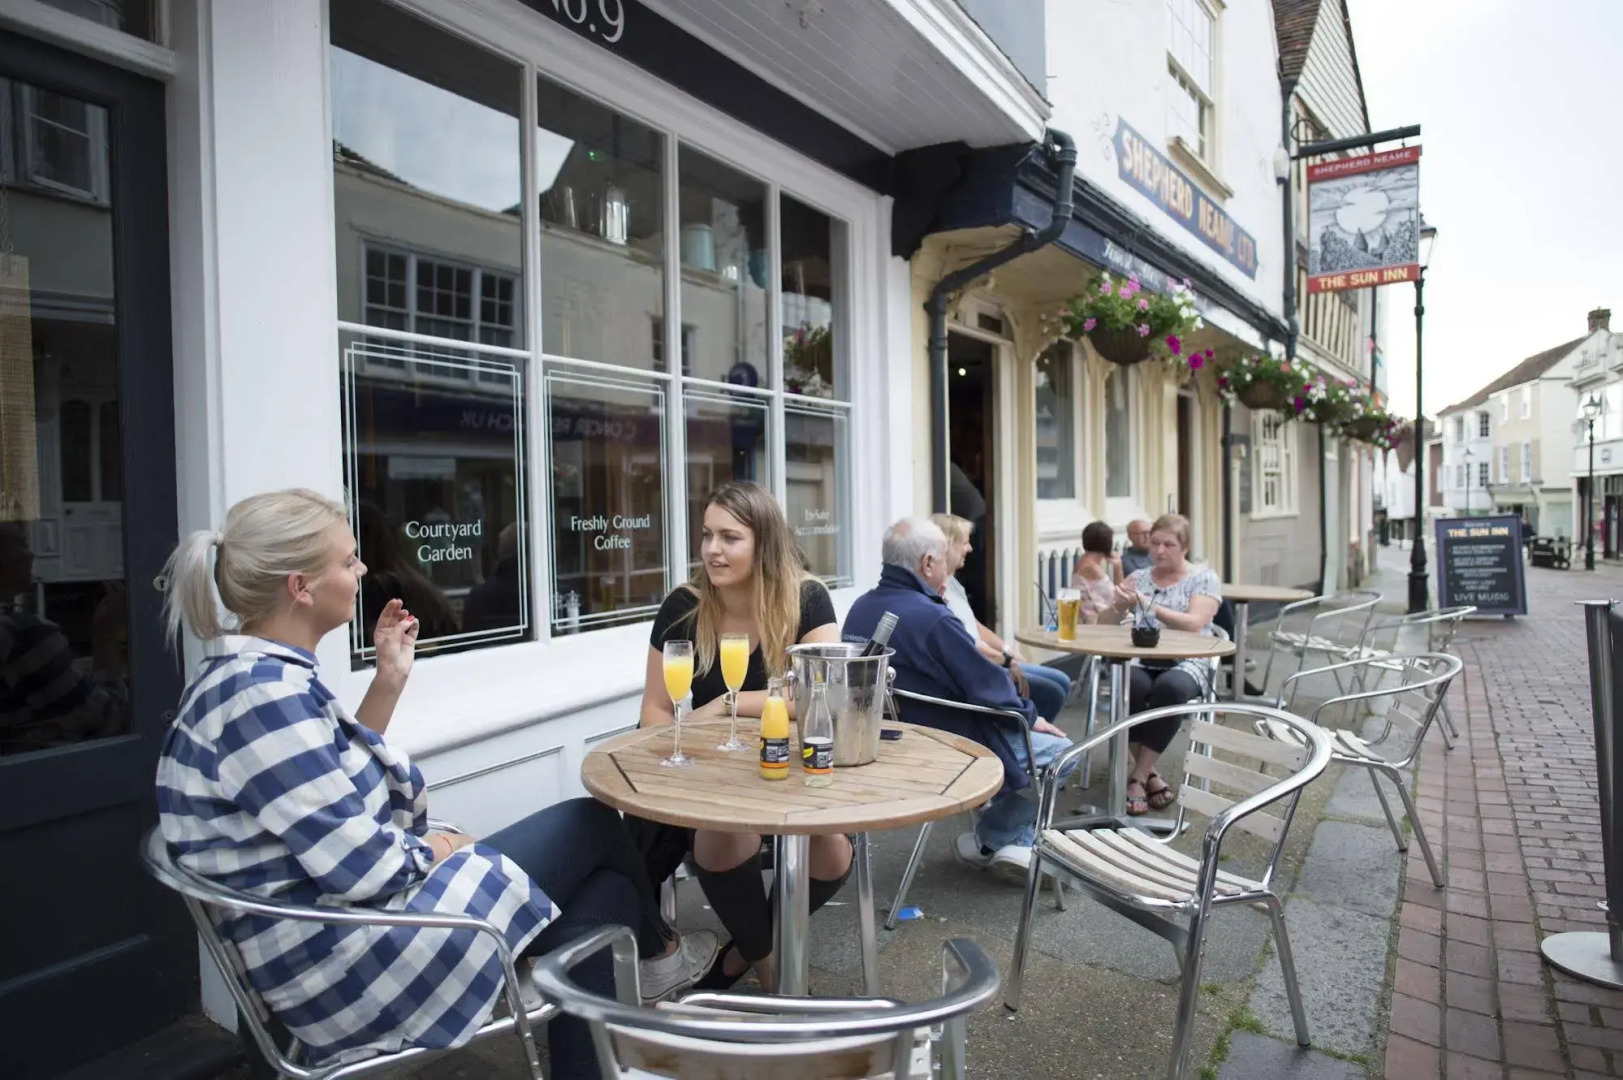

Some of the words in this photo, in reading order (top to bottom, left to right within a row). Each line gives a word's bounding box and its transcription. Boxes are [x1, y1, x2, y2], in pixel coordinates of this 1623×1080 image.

[552, 0, 625, 43] o.9
[1314, 158, 1371, 175] SHEPHERD
[1374, 151, 1411, 163] NEAME
[1122, 130, 1193, 221] SHEPHERD
[1319, 275, 1346, 290] THE
[1350, 271, 1378, 286] SUN
[1384, 267, 1408, 281] INN
[405, 519, 482, 541] Courtyard
[571, 514, 609, 534] Freshly
[613, 514, 650, 530] Ground
[1448, 528, 1468, 537] THE
[1469, 527, 1489, 536] SUN
[1491, 526, 1509, 536] INN
[417, 544, 472, 562] Garden
[594, 535, 631, 550] Coffee
[1454, 592, 1475, 601] LIVE
[1478, 591, 1509, 601] MUSIC
